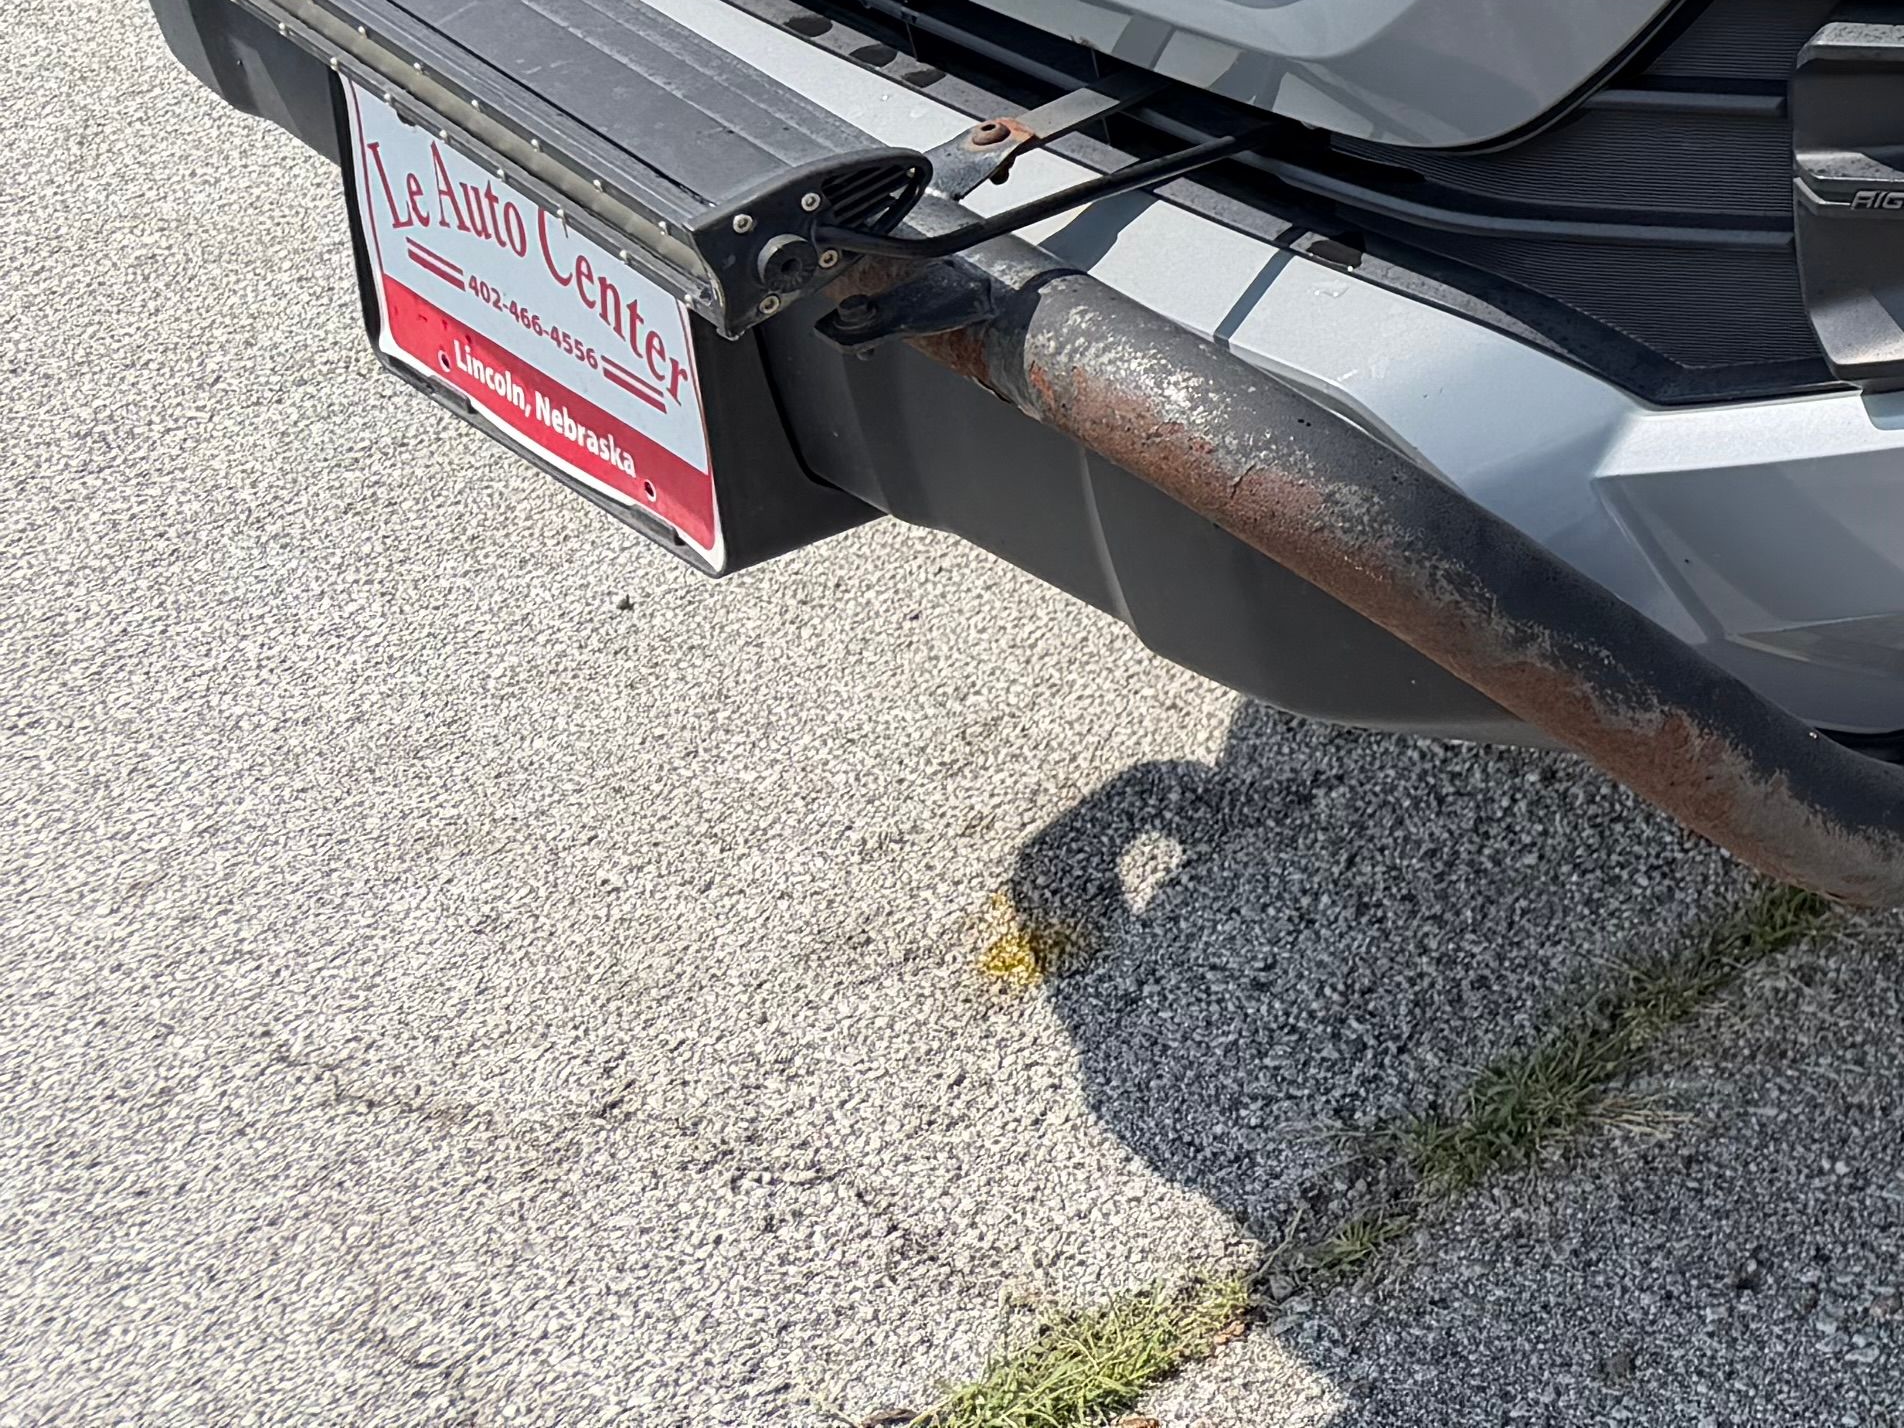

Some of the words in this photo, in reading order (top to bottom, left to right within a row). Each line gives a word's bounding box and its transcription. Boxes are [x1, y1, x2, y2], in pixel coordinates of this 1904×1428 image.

[367, 140, 430, 230] Le
[430, 139, 527, 258] Auto
[537, 206, 689, 407] Center
[468, 274, 599, 370] 402-466-4556
[453, 340, 531, 417] Lincoln,
[535, 390, 637, 479] Nebraska
